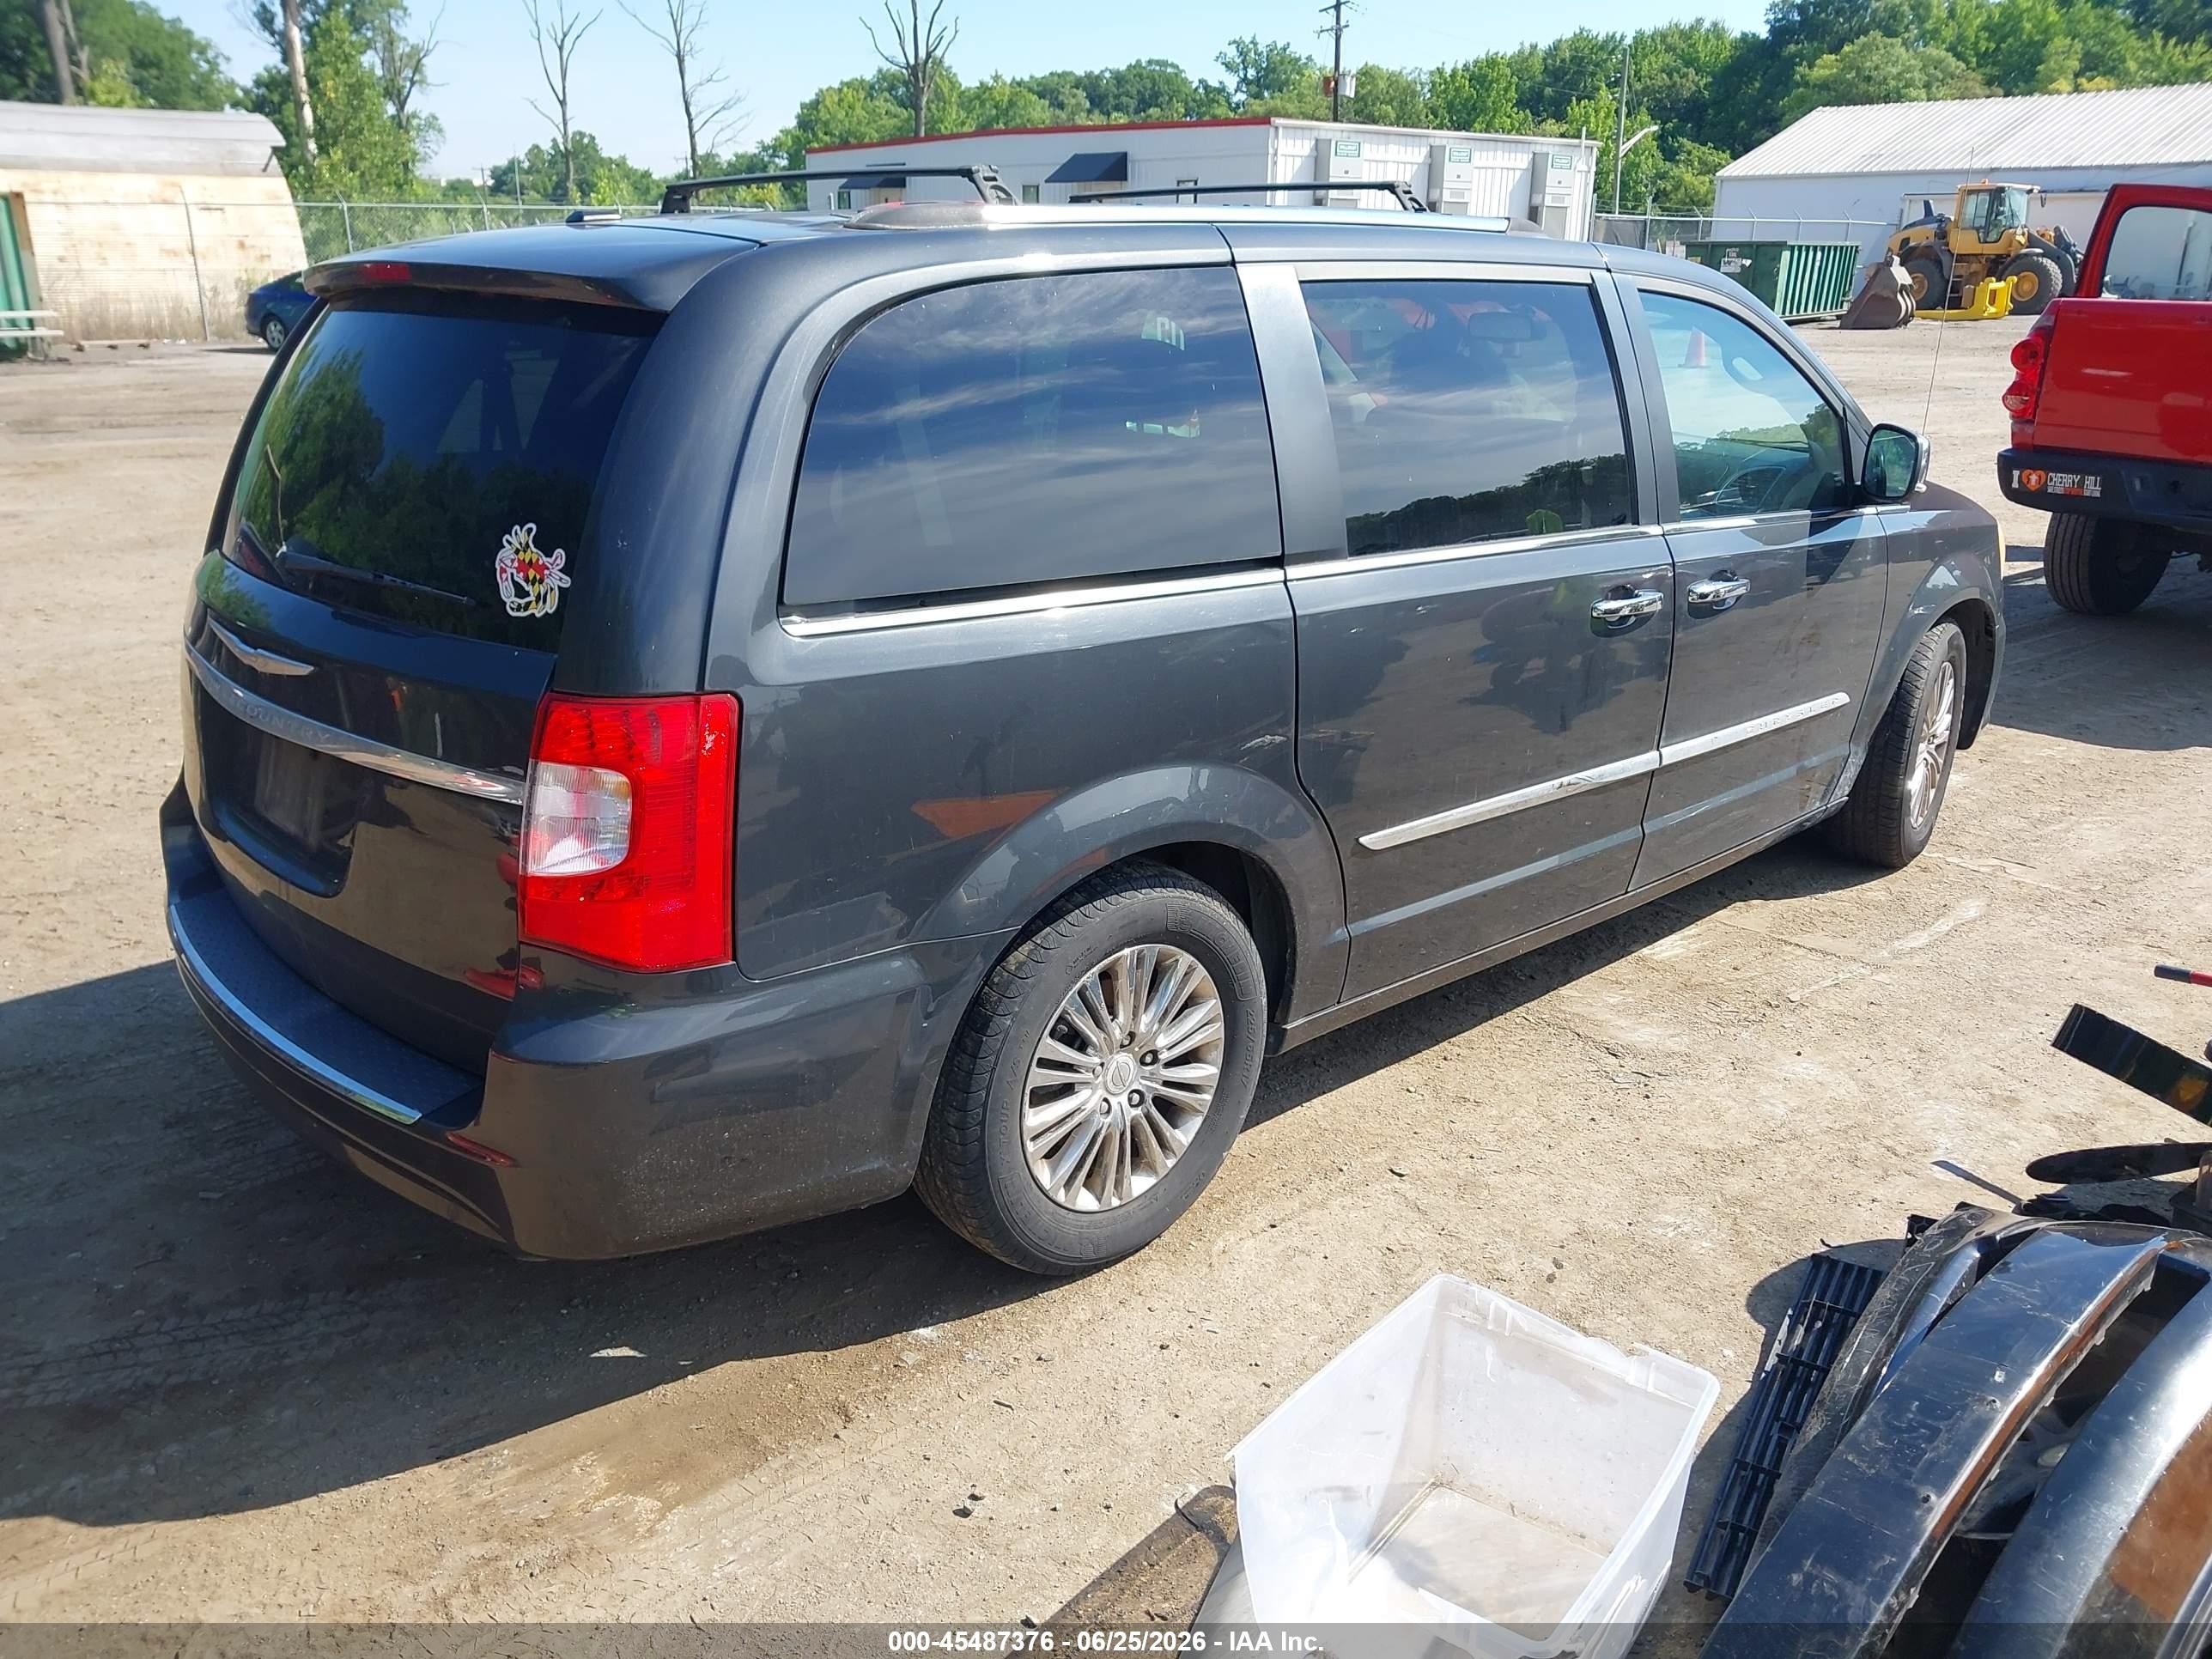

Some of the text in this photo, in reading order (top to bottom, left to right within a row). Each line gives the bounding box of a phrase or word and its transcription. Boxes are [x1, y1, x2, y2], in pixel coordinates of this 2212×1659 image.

[2011, 470, 2102, 490] I CHERRY HILL
